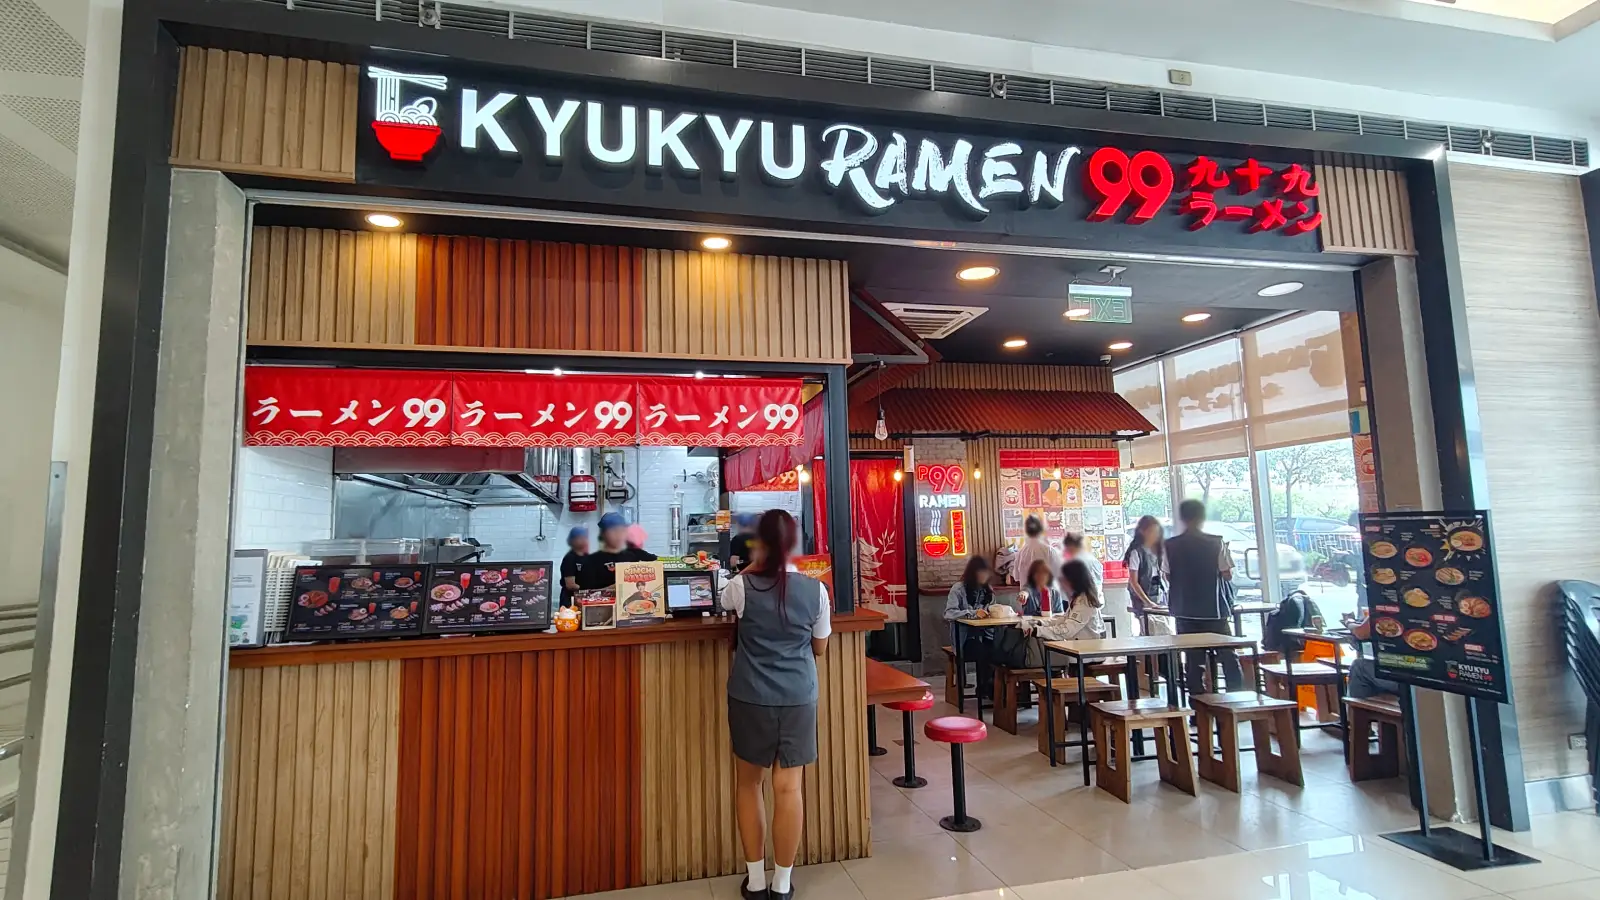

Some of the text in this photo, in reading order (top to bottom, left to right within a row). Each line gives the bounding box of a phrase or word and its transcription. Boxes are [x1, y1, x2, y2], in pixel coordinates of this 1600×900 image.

[460, 88, 1175, 219] KYUKYU RAMEN 99
[1186, 155, 1319, 196] 九十九
[1187, 191, 1323, 232] ラーメン
[919, 494, 967, 509] RAMEN
